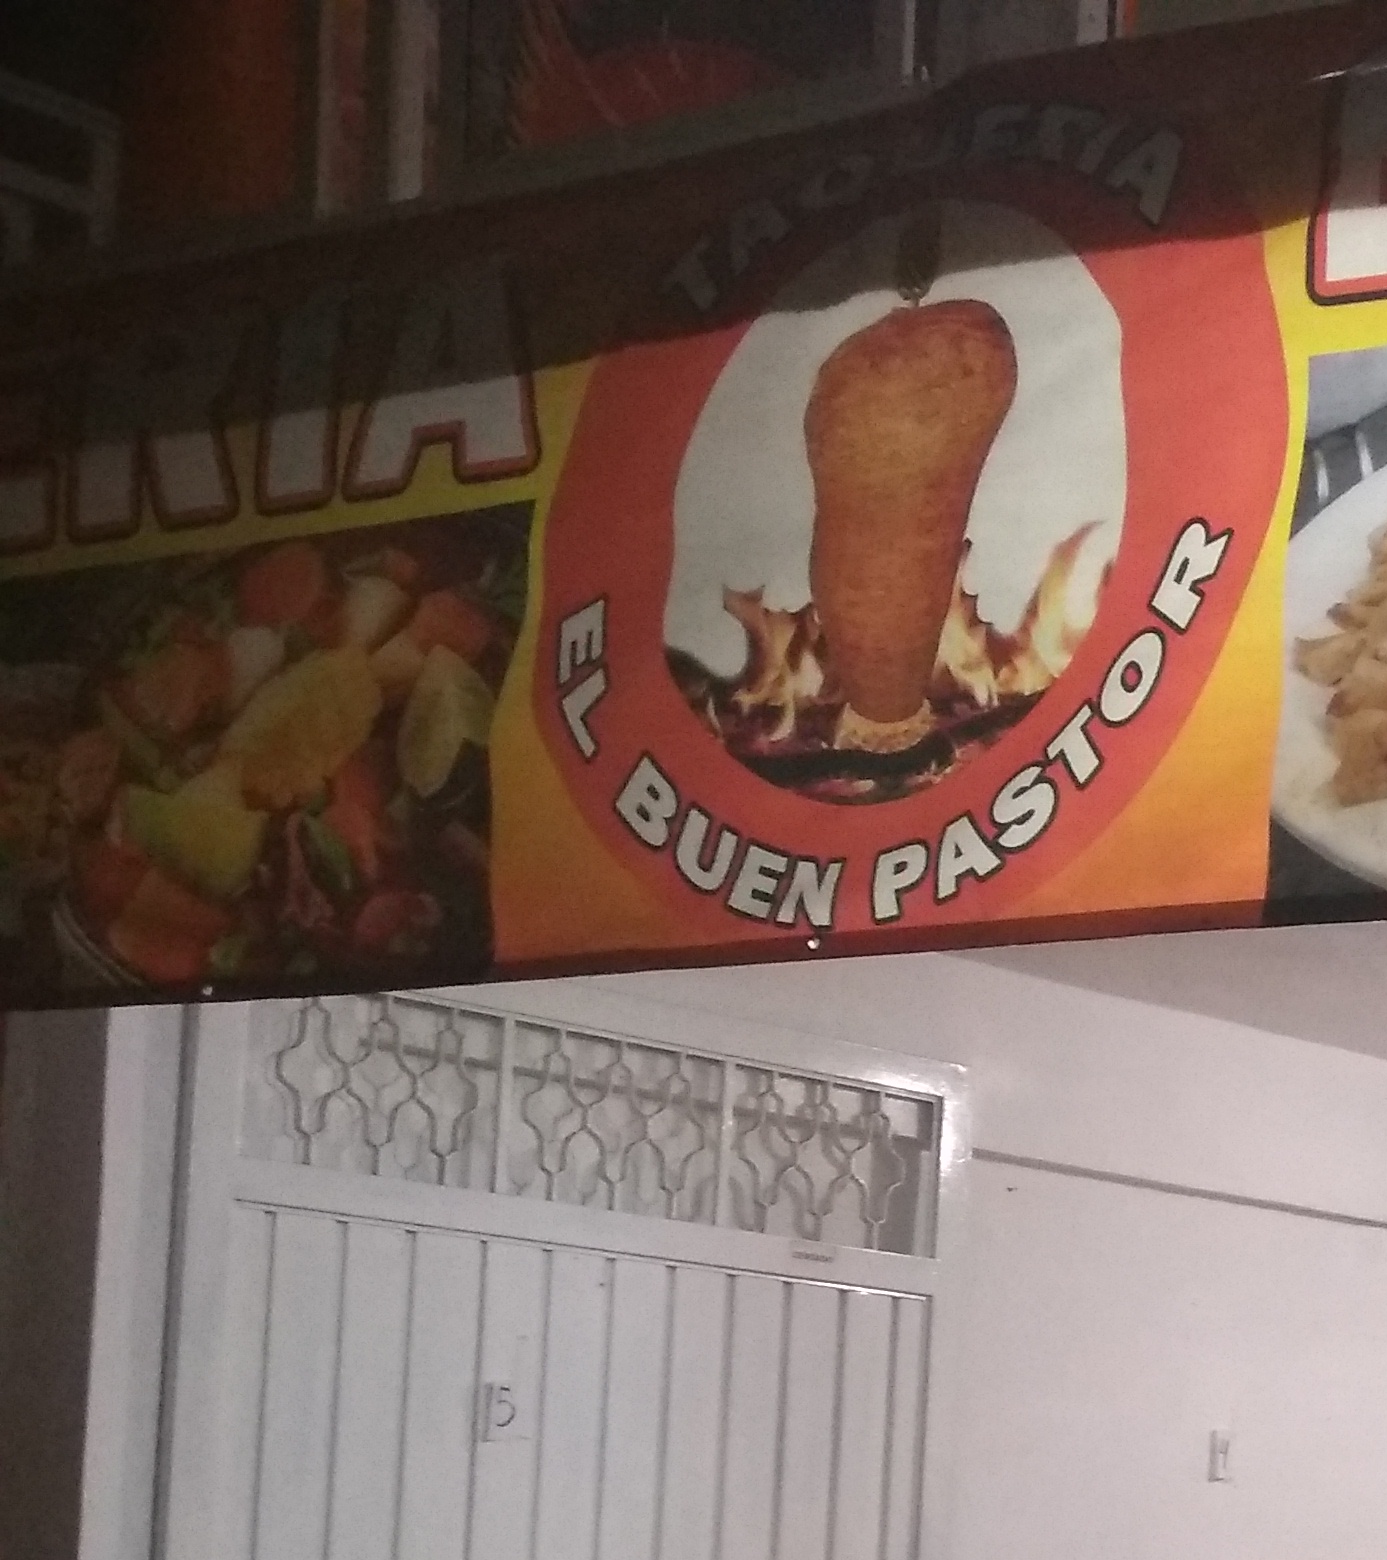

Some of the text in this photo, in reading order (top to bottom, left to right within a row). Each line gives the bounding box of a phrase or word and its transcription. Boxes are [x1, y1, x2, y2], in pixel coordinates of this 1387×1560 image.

[557, 516, 1235, 928] EL BUEN PASTOR
